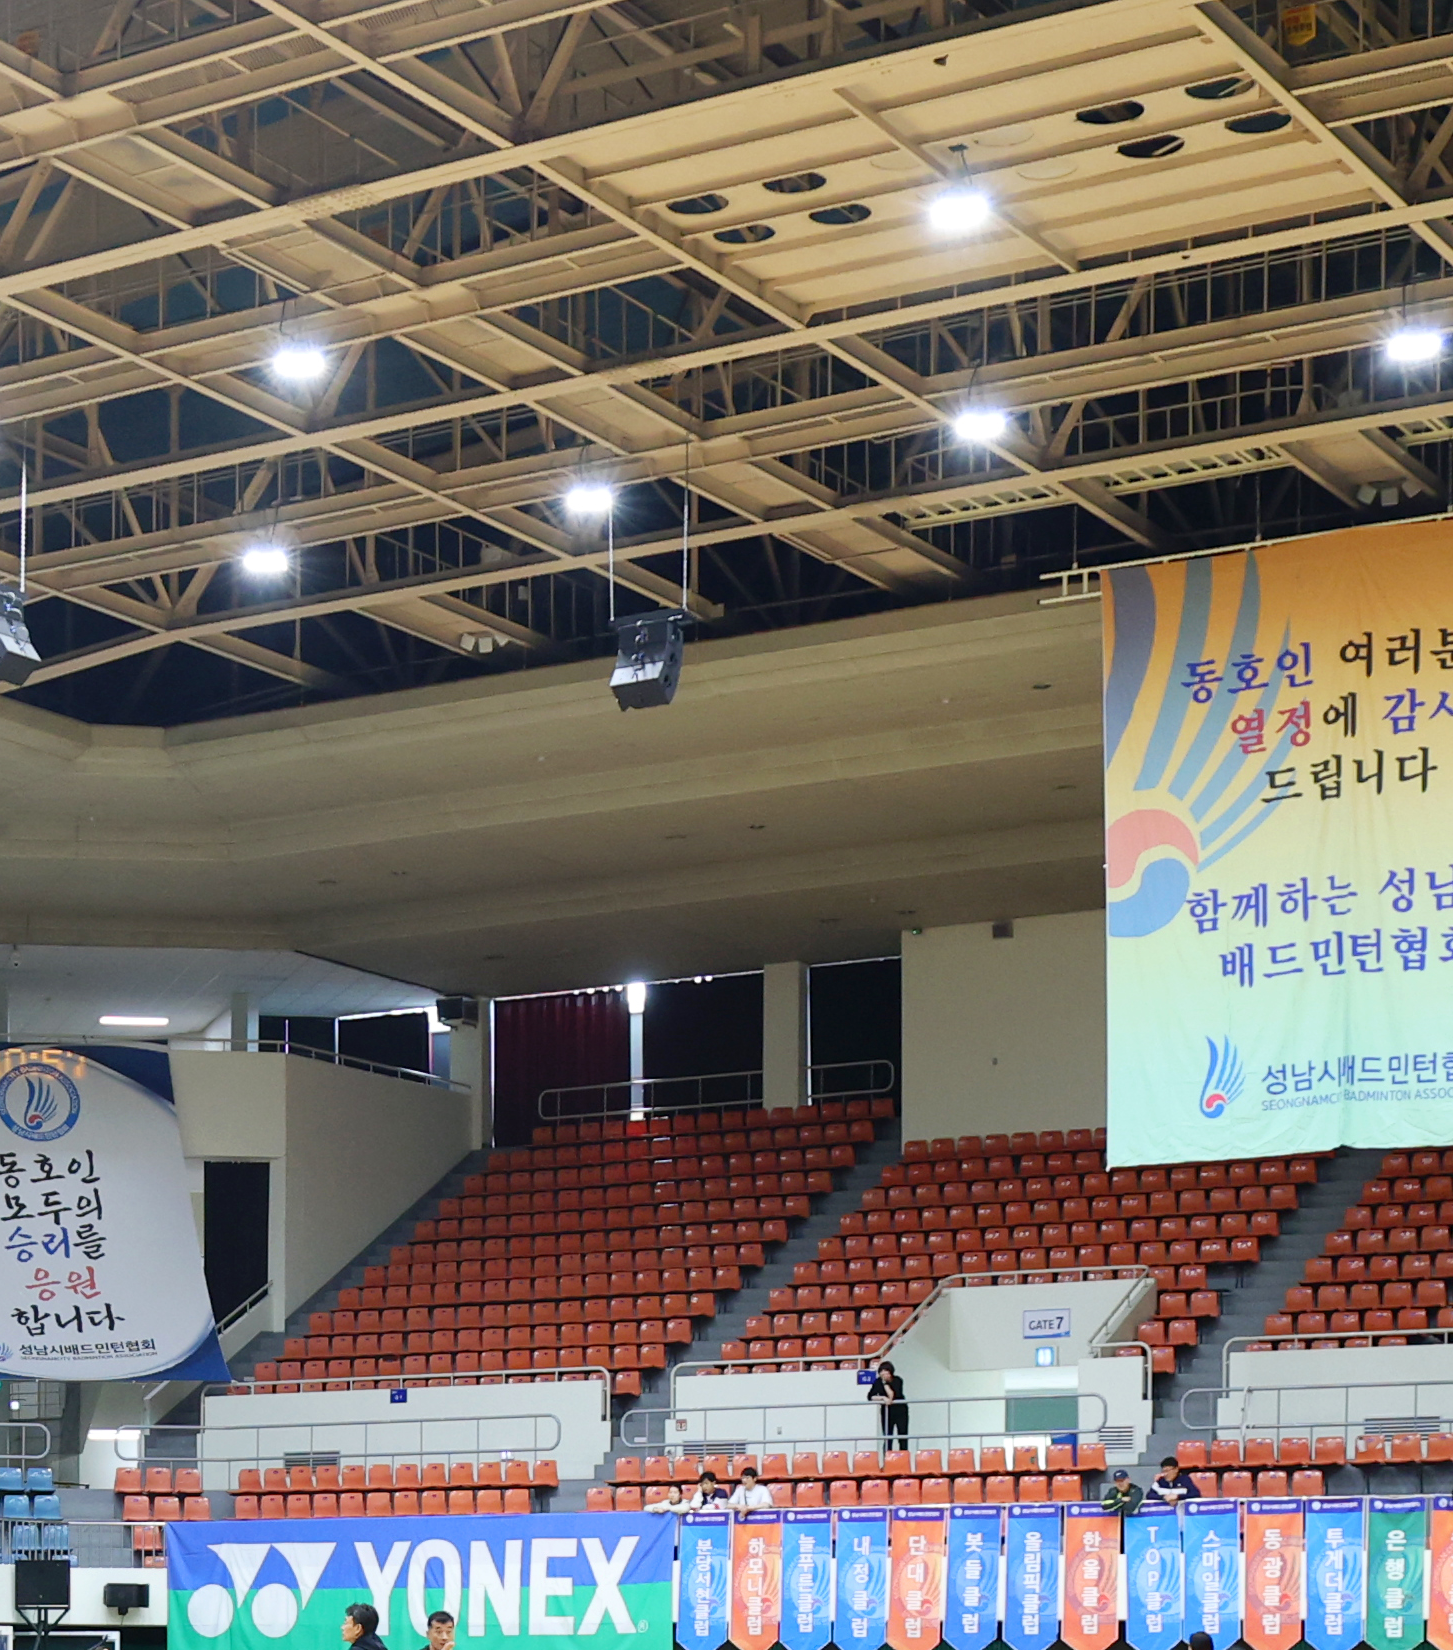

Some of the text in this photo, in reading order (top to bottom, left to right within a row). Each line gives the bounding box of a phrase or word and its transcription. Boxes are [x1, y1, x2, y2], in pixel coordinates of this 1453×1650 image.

[1180, 641, 1315, 704] 동호인
[1230, 692, 1360, 755] 열정에
[1260, 746, 1439, 804] 드립니다
[1185, 875, 1359, 935] 함께하는
[1262, 1090, 1342, 1112] SEONGNAMCI
[1344, 1088, 1411, 1102] BADMINTON
[0, 1188, 103, 1226] 모두의
[4, 1224, 107, 1263] 승리를
[10, 1302, 126, 1337] 합니다
[24, 1265, 102, 1302] 응원
[19, 1338, 156, 1356] 성남시배드민턴협회
[354, 1534, 641, 1638] YONEX
[694, 1538, 711, 1637] 분당서현클럽
[746, 1536, 766, 1635] 하모니클럽
[797, 1533, 813, 1633] 늘푸른클럽
[851, 1534, 871, 1638] 내정클럽
[905, 1535, 927, 1638] 단대클럽
[961, 1532, 983, 1633] 봇들클럽
[1021, 1532, 1042, 1635] 올림픽클럽
[1080, 1531, 1102, 1635] 한울클럽
[1144, 1526, 1163, 1633] TOP클럽
[1200, 1530, 1221, 1635] 스마일클럽
[1261, 1528, 1284, 1635] 동광클럽
[1323, 1527, 1345, 1635] 투게더클럽
[1384, 1529, 1406, 1638] 은행클럽
